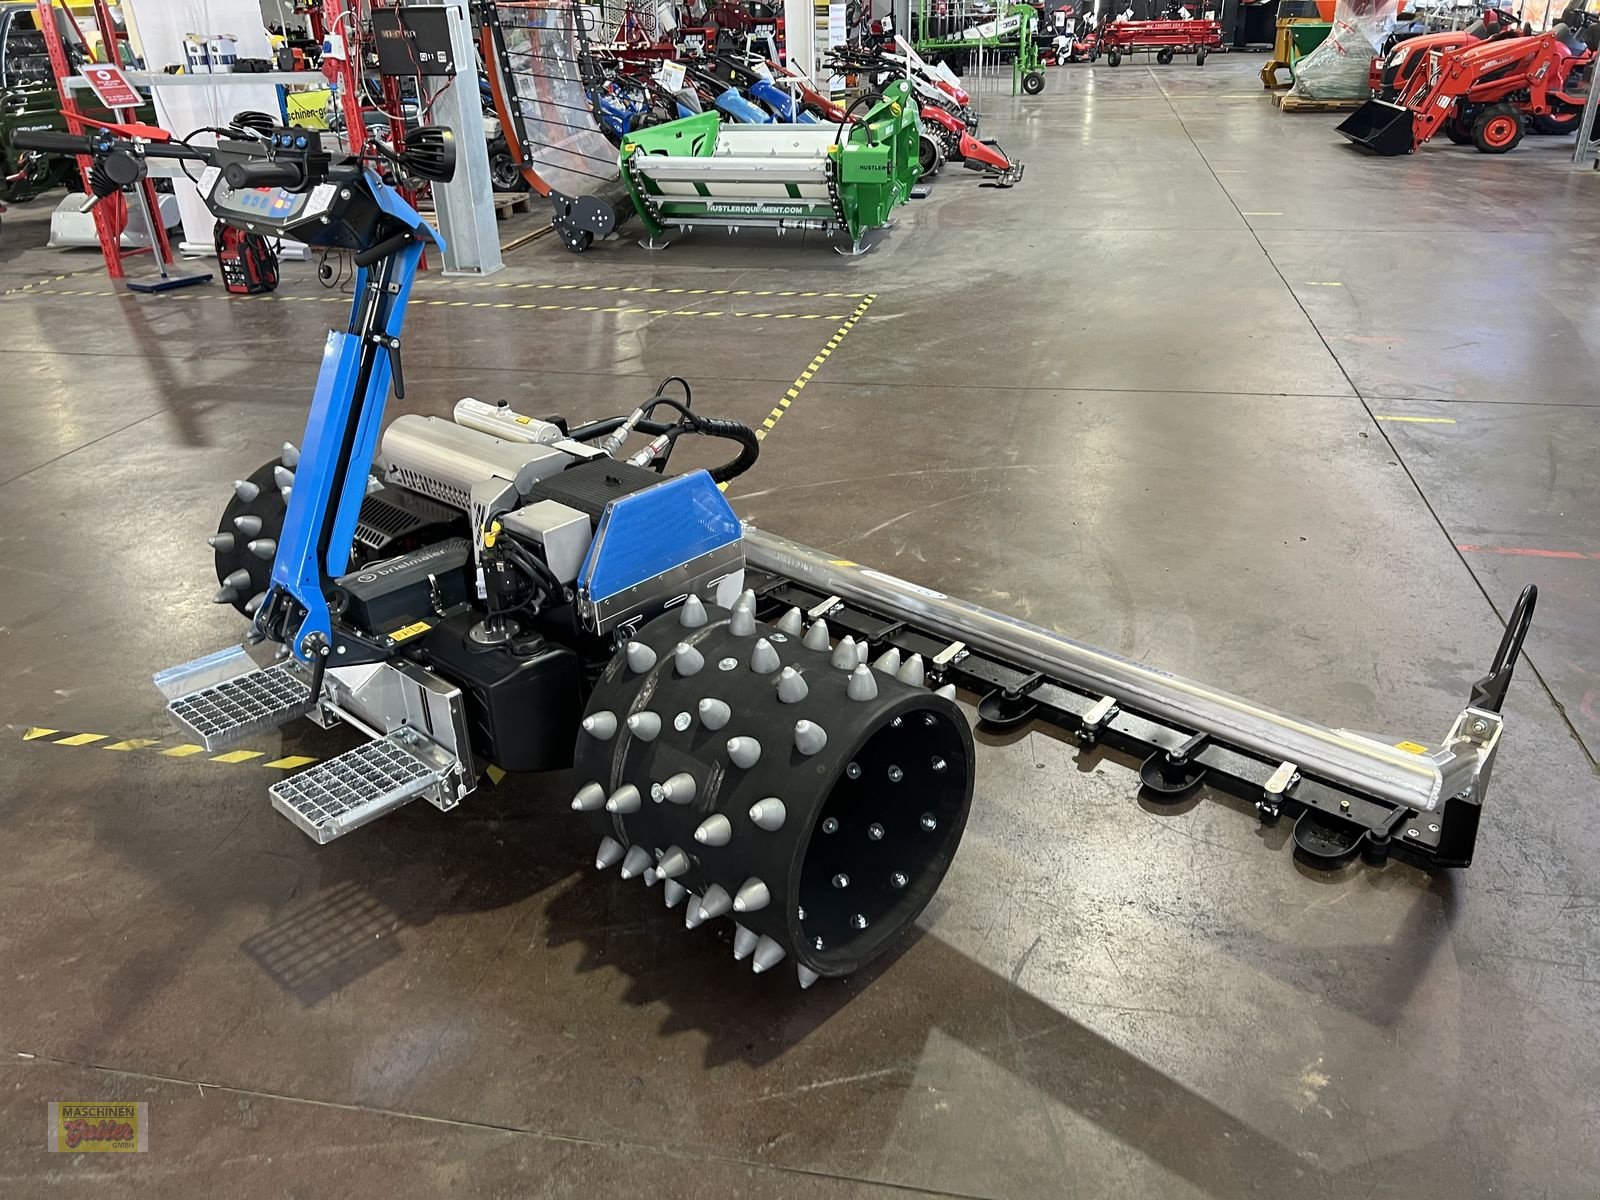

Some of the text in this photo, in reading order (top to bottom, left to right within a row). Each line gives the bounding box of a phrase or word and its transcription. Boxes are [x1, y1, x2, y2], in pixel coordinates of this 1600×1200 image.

[1003, 19, 1018, 28] 350
[706, 204, 803, 214] USTLEREQUIMENT.COM
[378, 549, 445, 576] brielmaier
